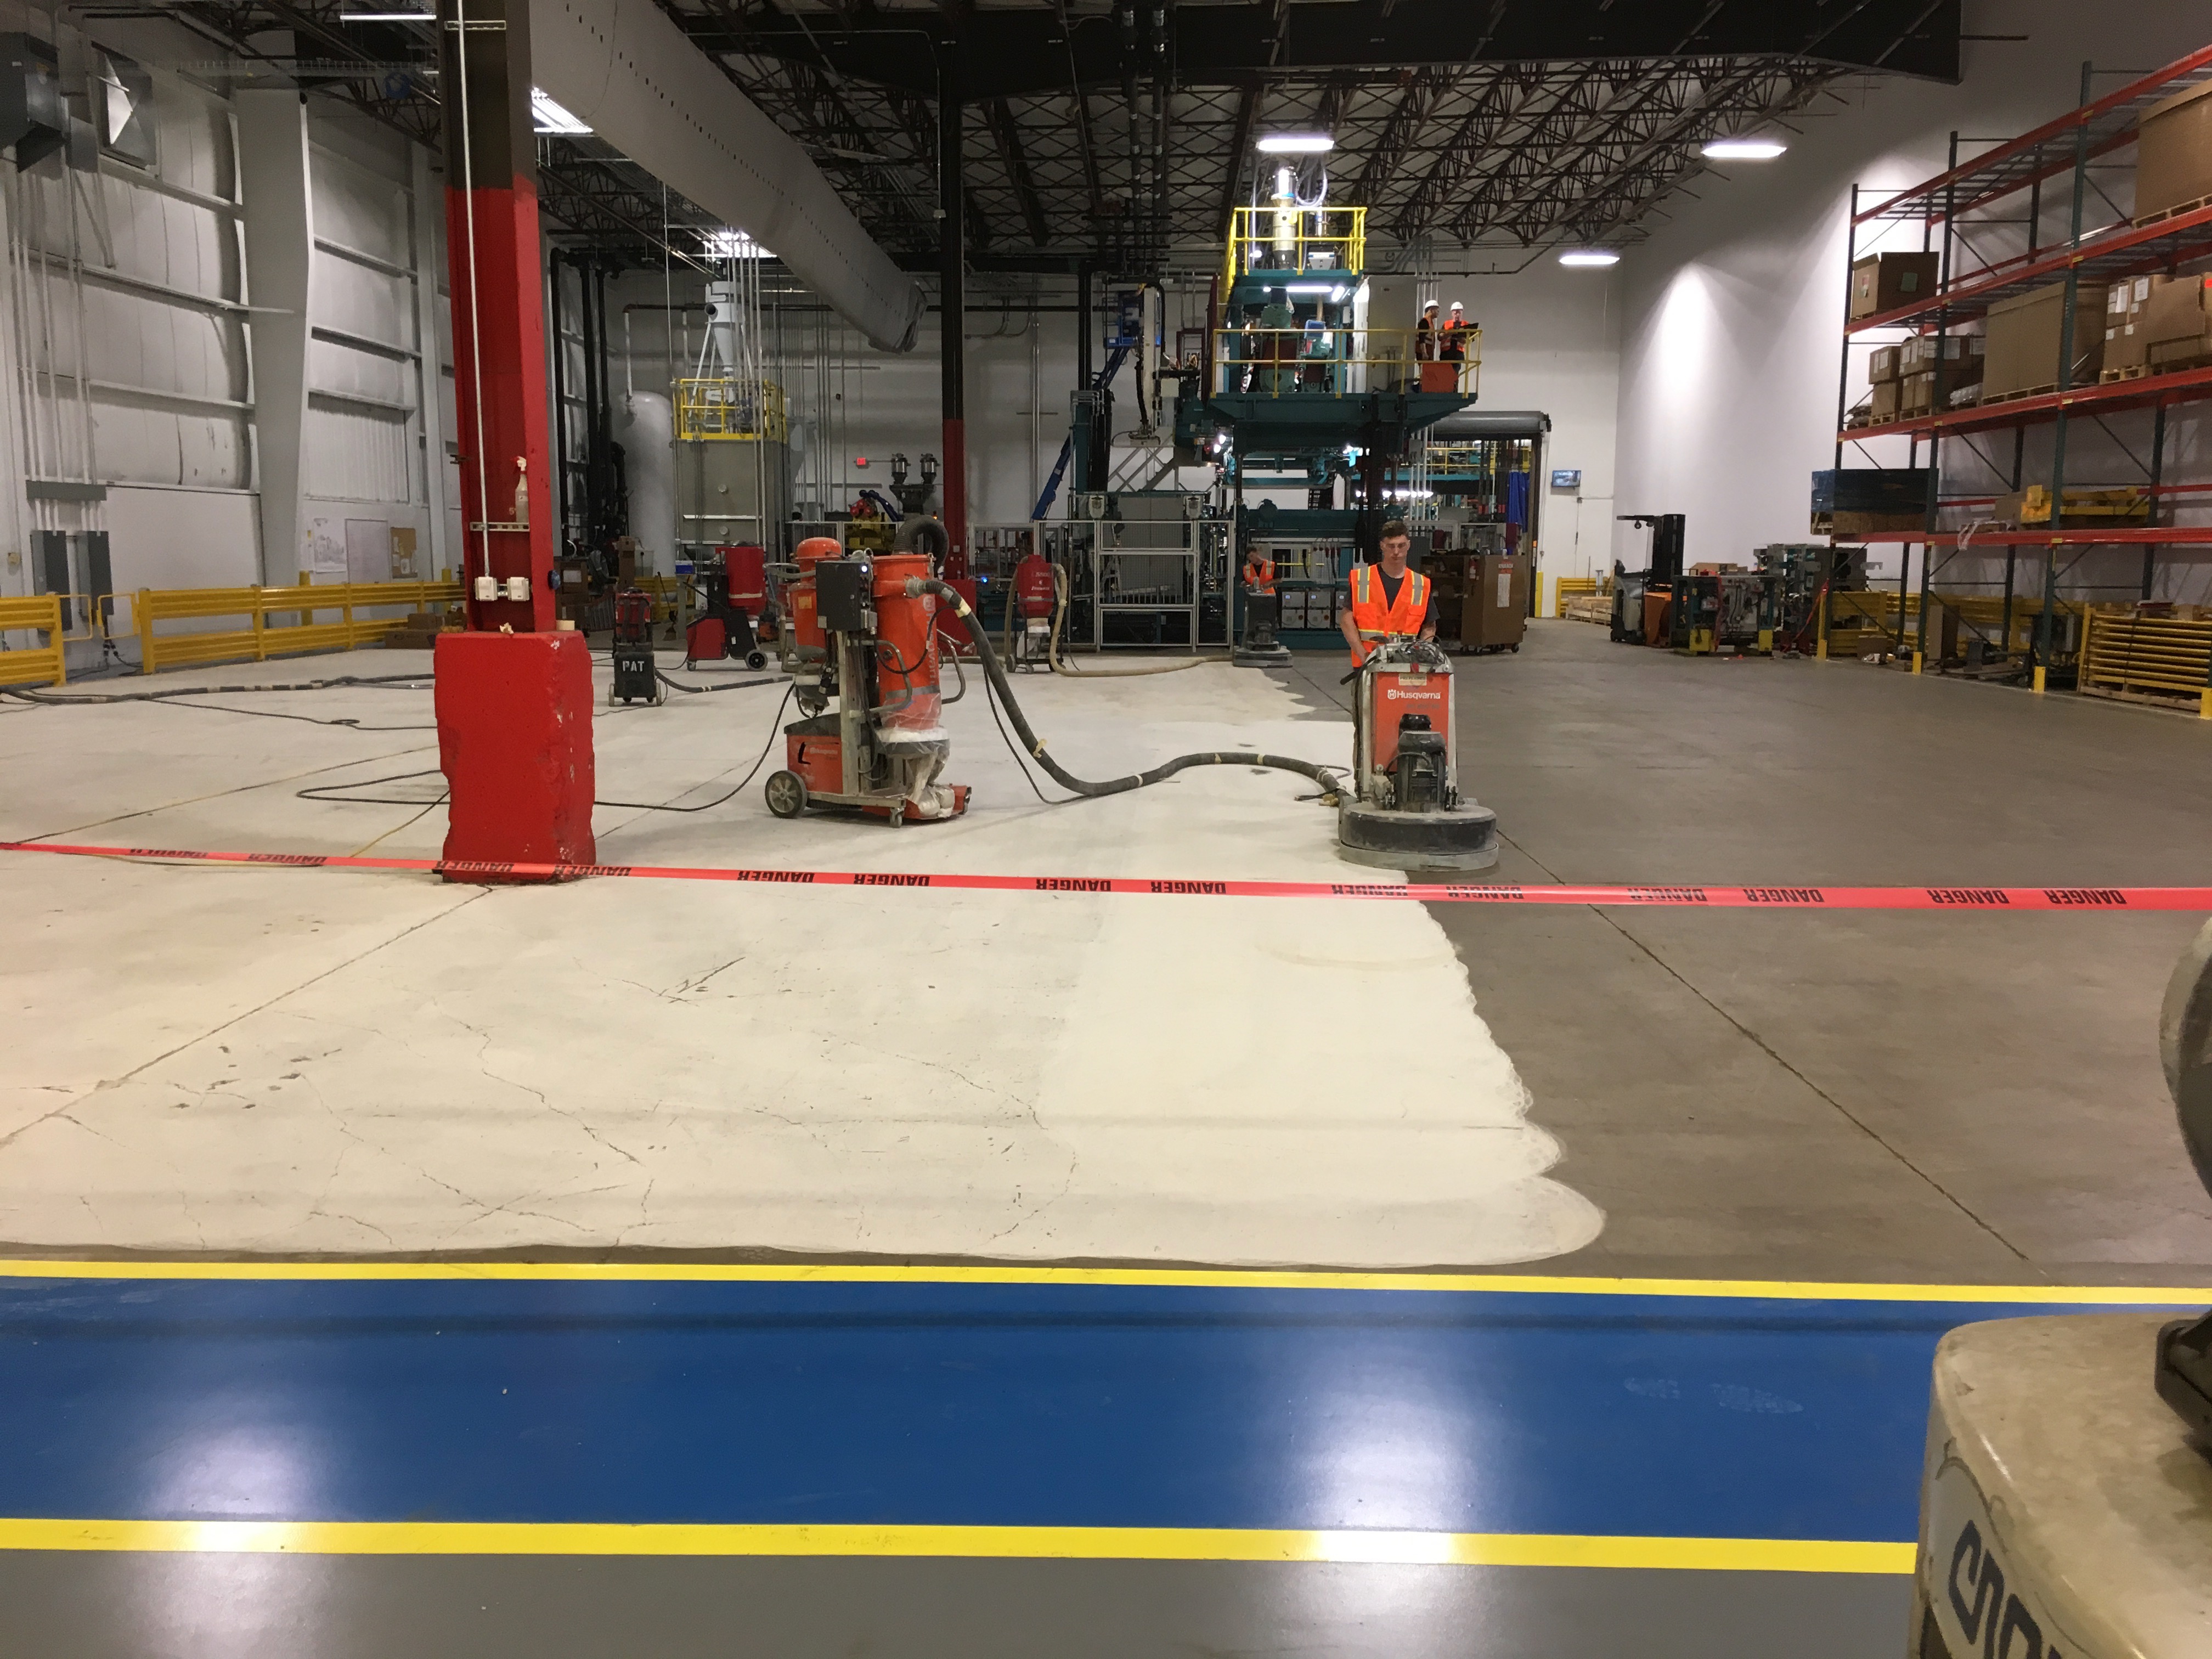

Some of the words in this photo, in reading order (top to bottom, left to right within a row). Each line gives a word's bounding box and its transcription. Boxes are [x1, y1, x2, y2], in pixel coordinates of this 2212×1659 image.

[622, 661, 645, 672] PAT
[1397, 691, 1441, 699] Husqvarna
[737, 870, 815, 883] DANGER
[854, 873, 930, 886] DANGER
[1036, 879, 1111, 891] DANGER
[1151, 881, 1226, 894] DANGER
[1331, 884, 1408, 896] DANGER
[1743, 889, 1824, 902] DANGER
[1927, 890, 2010, 904] DANGER
[2042, 889, 2127, 905] DANGER
